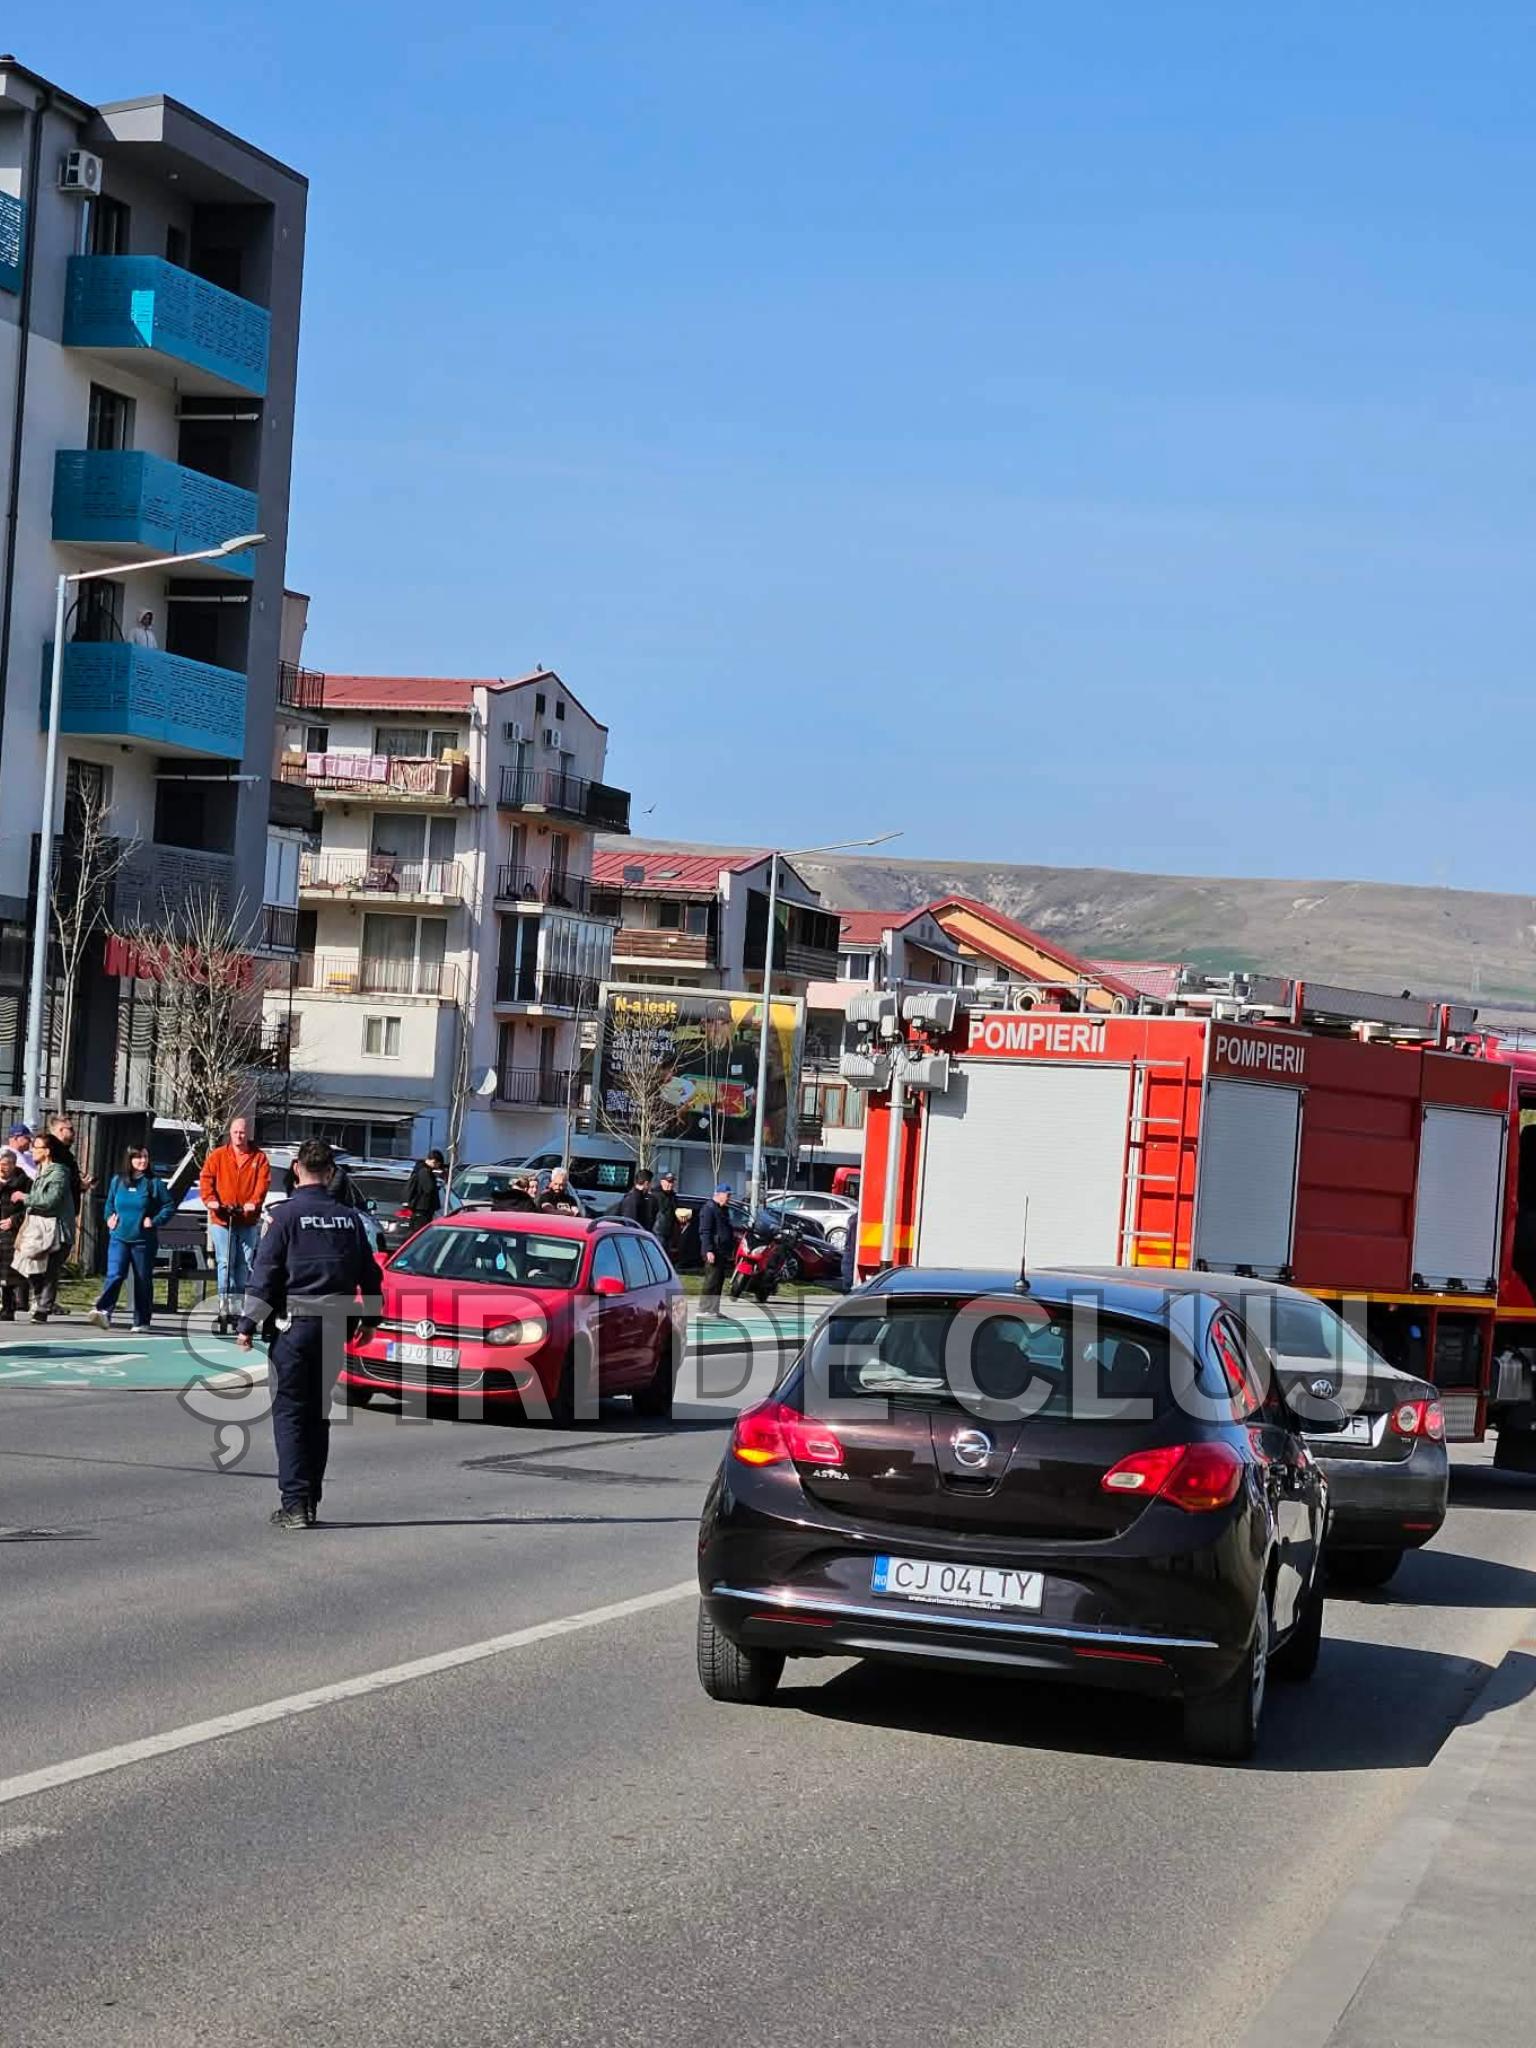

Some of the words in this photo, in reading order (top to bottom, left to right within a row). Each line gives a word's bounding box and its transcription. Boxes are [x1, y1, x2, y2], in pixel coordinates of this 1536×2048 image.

[969, 1021, 1106, 1053] POMPIERII
[1215, 1036, 1306, 1074] POMPIERII
[813, 1469, 849, 1480] ASTRA
[895, 1562, 930, 1589] CJ
